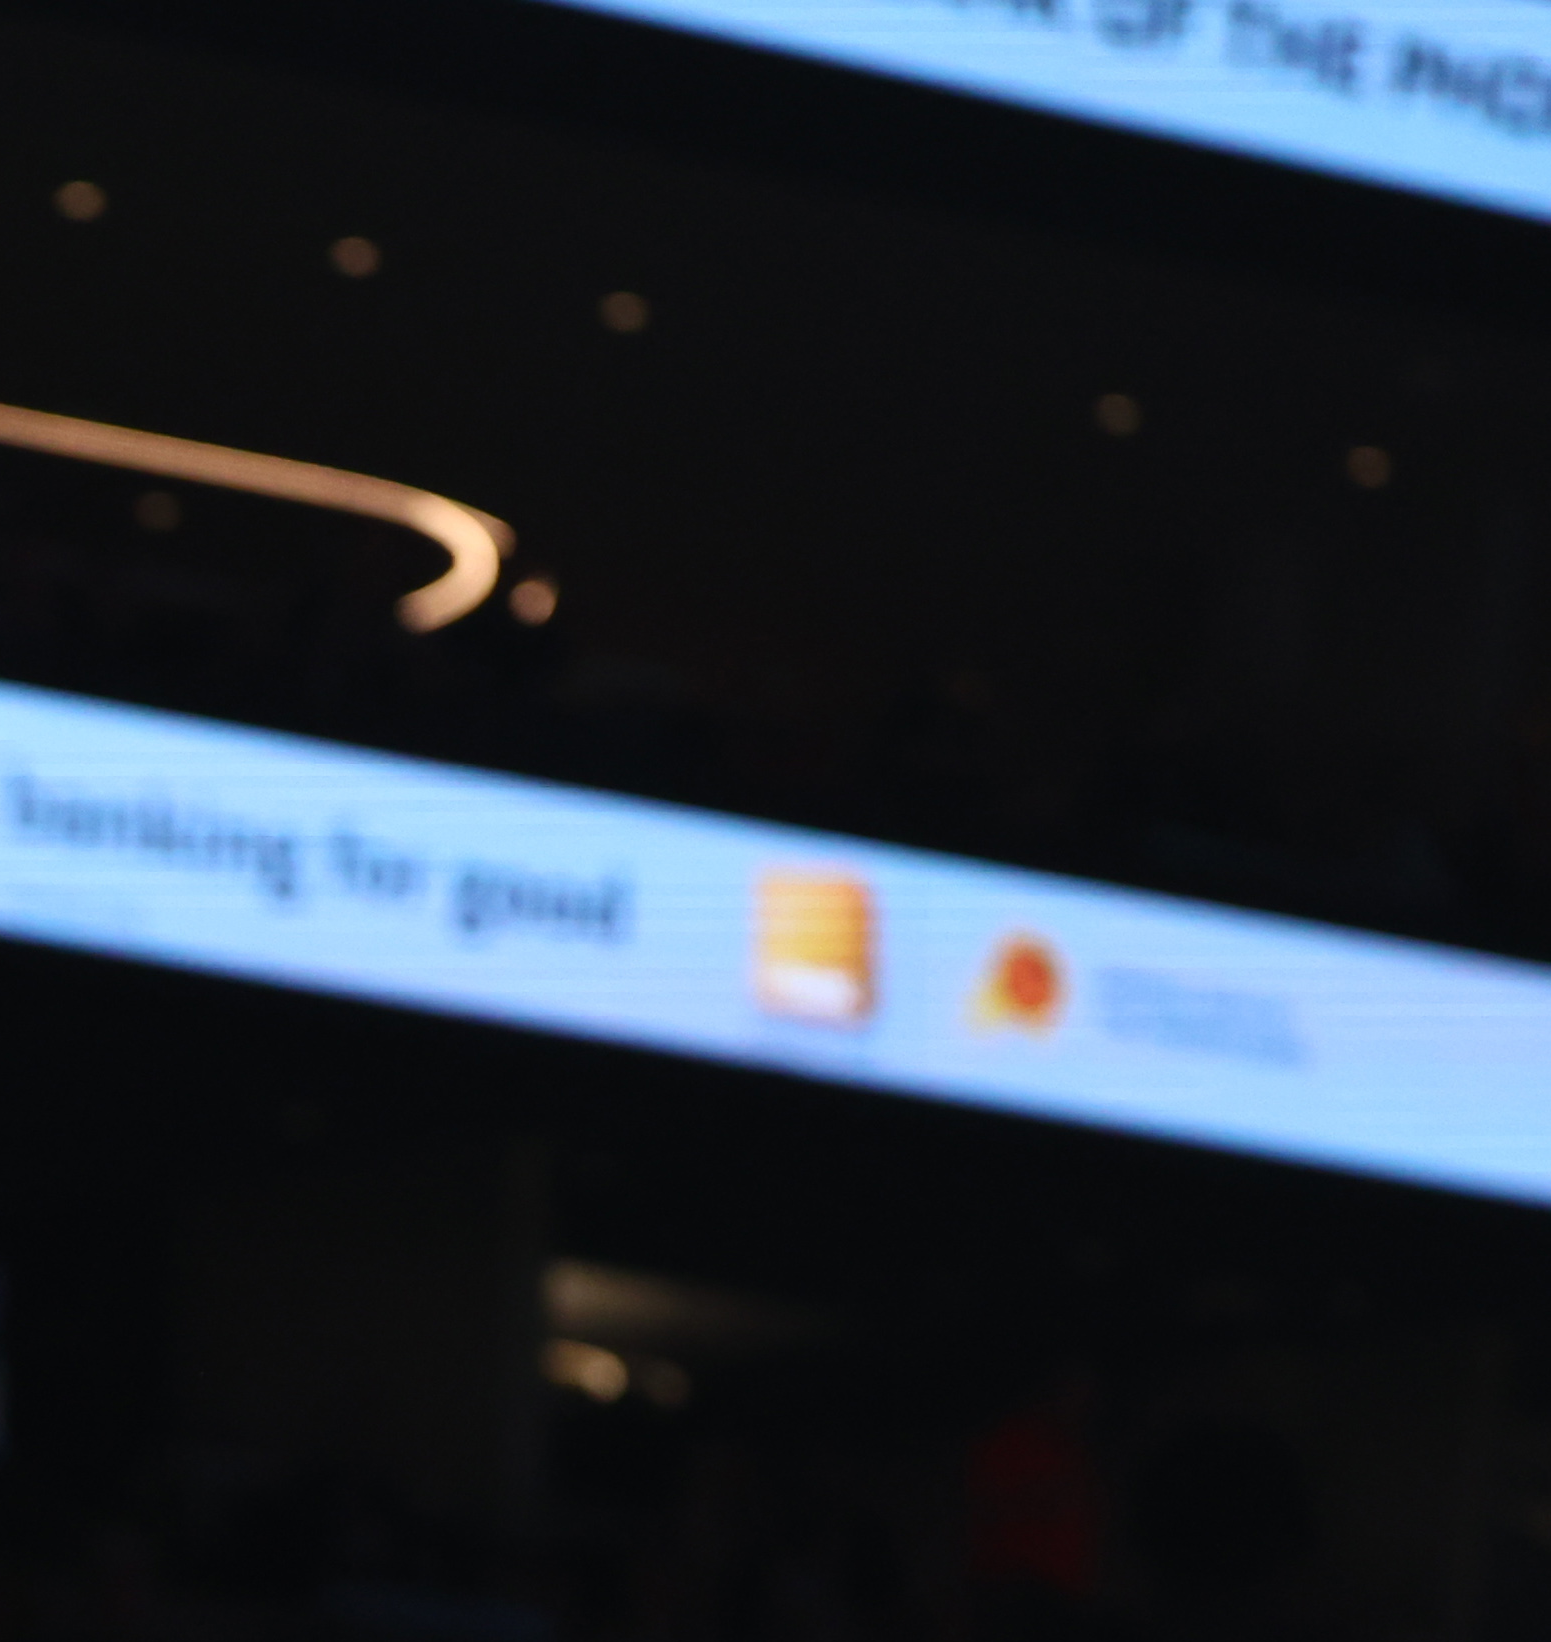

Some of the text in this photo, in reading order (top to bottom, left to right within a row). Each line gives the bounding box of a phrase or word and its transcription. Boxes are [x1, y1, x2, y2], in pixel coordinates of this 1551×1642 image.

[1, 760, 635, 944] banking for good
